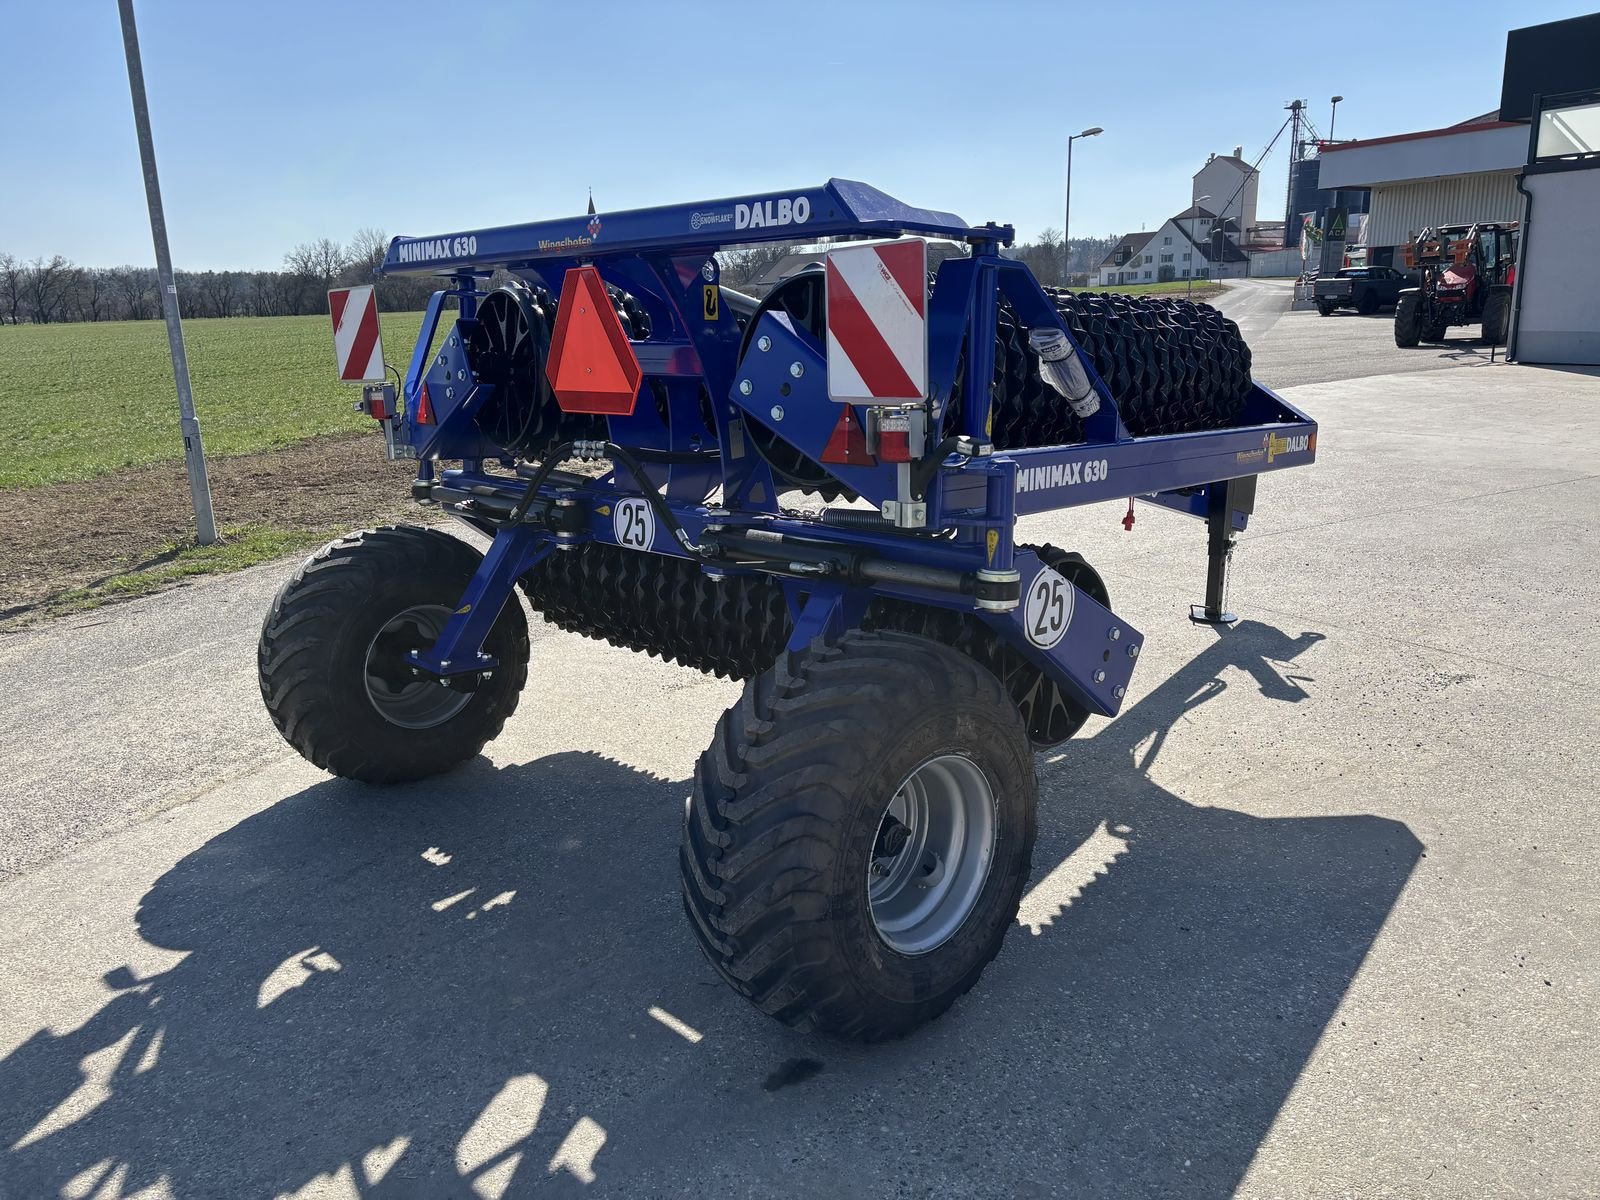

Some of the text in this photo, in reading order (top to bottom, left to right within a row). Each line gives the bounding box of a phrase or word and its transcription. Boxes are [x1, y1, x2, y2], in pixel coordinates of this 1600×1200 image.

[735, 196, 810, 230] DALBO
[399, 236, 477, 262] MINIMAX 630
[1286, 435, 1309, 453] DALBO
[1016, 459, 1108, 493] MINIMAX 630
[622, 503, 646, 546] 25
[1034, 579, 1065, 636] 25
